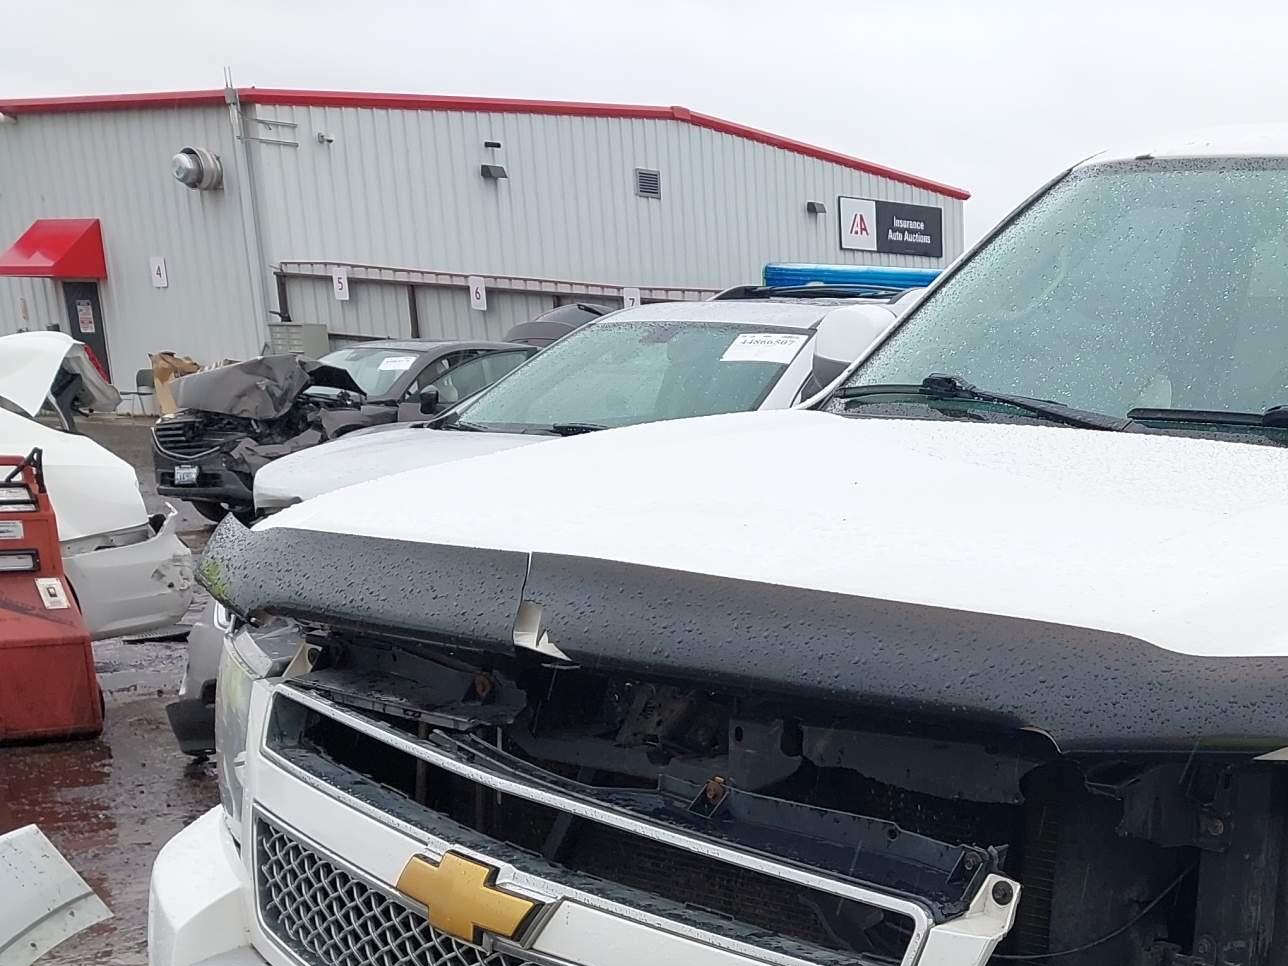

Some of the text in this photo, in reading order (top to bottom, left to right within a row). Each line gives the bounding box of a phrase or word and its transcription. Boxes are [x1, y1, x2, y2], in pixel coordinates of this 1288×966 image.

[893, 215, 925, 229] Insurance
[887, 228, 931, 244] Auto Auctions
[156, 264, 162, 279] 4
[337, 276, 344, 291] 5
[474, 286, 481, 300] 6
[629, 297, 635, 307] 7
